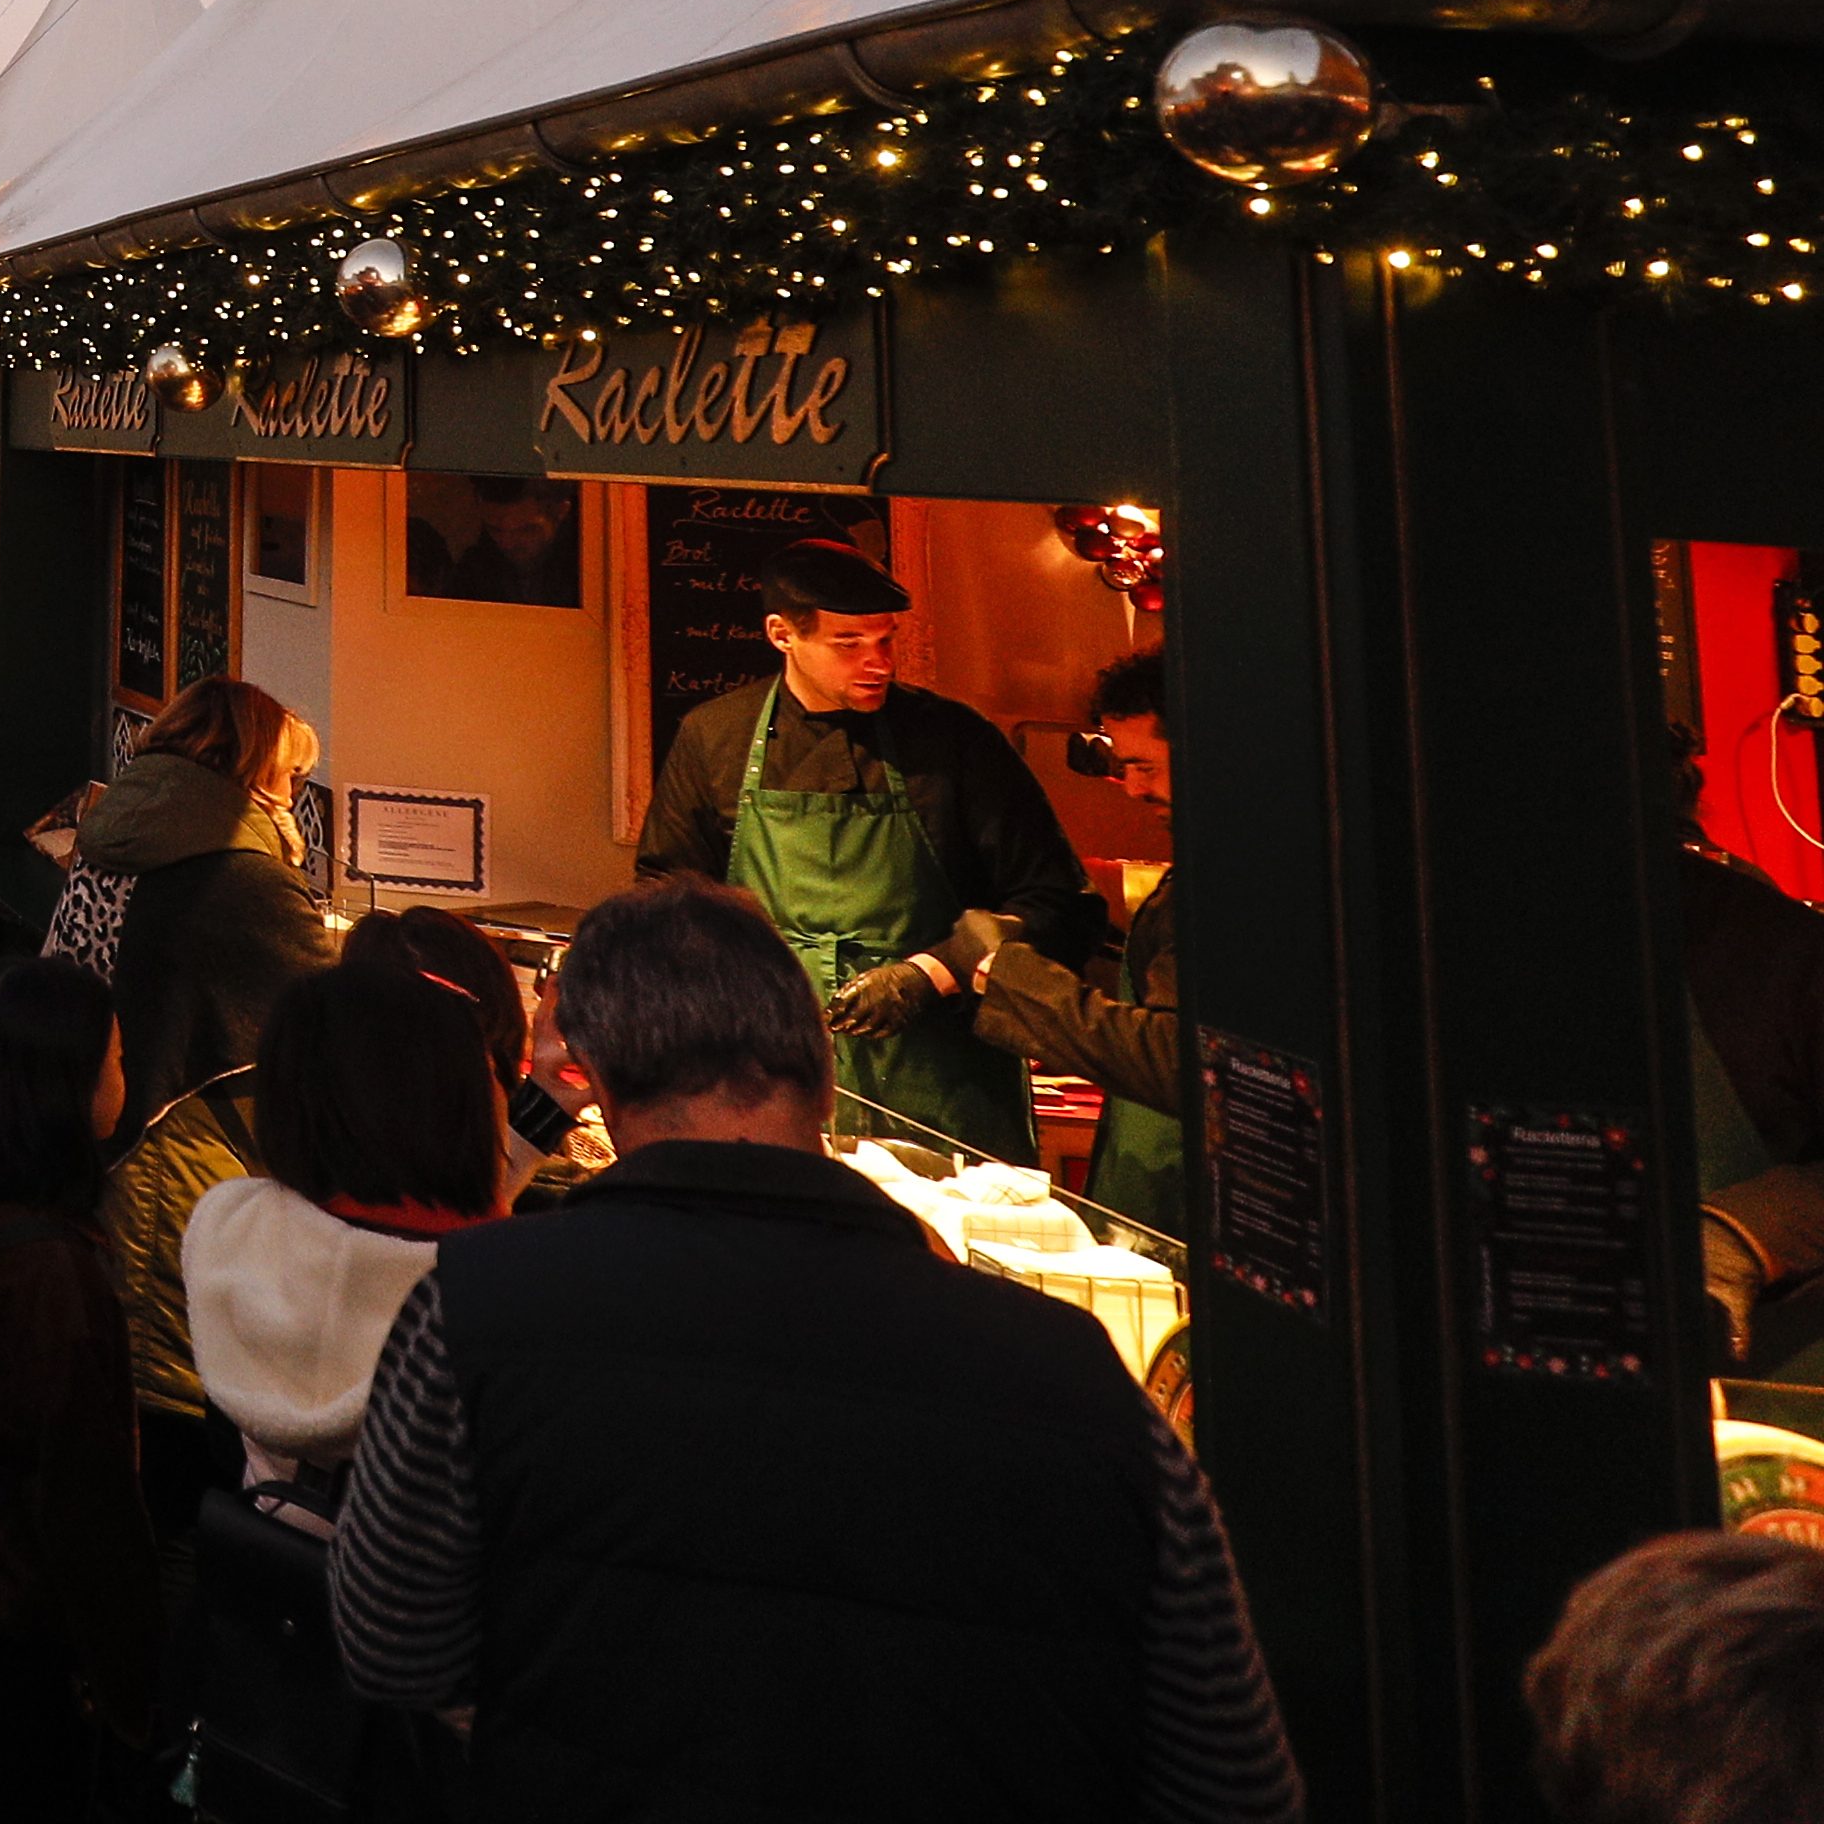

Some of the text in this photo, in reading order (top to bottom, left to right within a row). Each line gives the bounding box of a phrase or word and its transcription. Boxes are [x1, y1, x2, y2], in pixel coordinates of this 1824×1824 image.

[49, 366, 150, 431] Raclette
[539, 314, 849, 446] Raclette
[687, 488, 814, 523] Raclette
[666, 539, 716, 562] Brot
